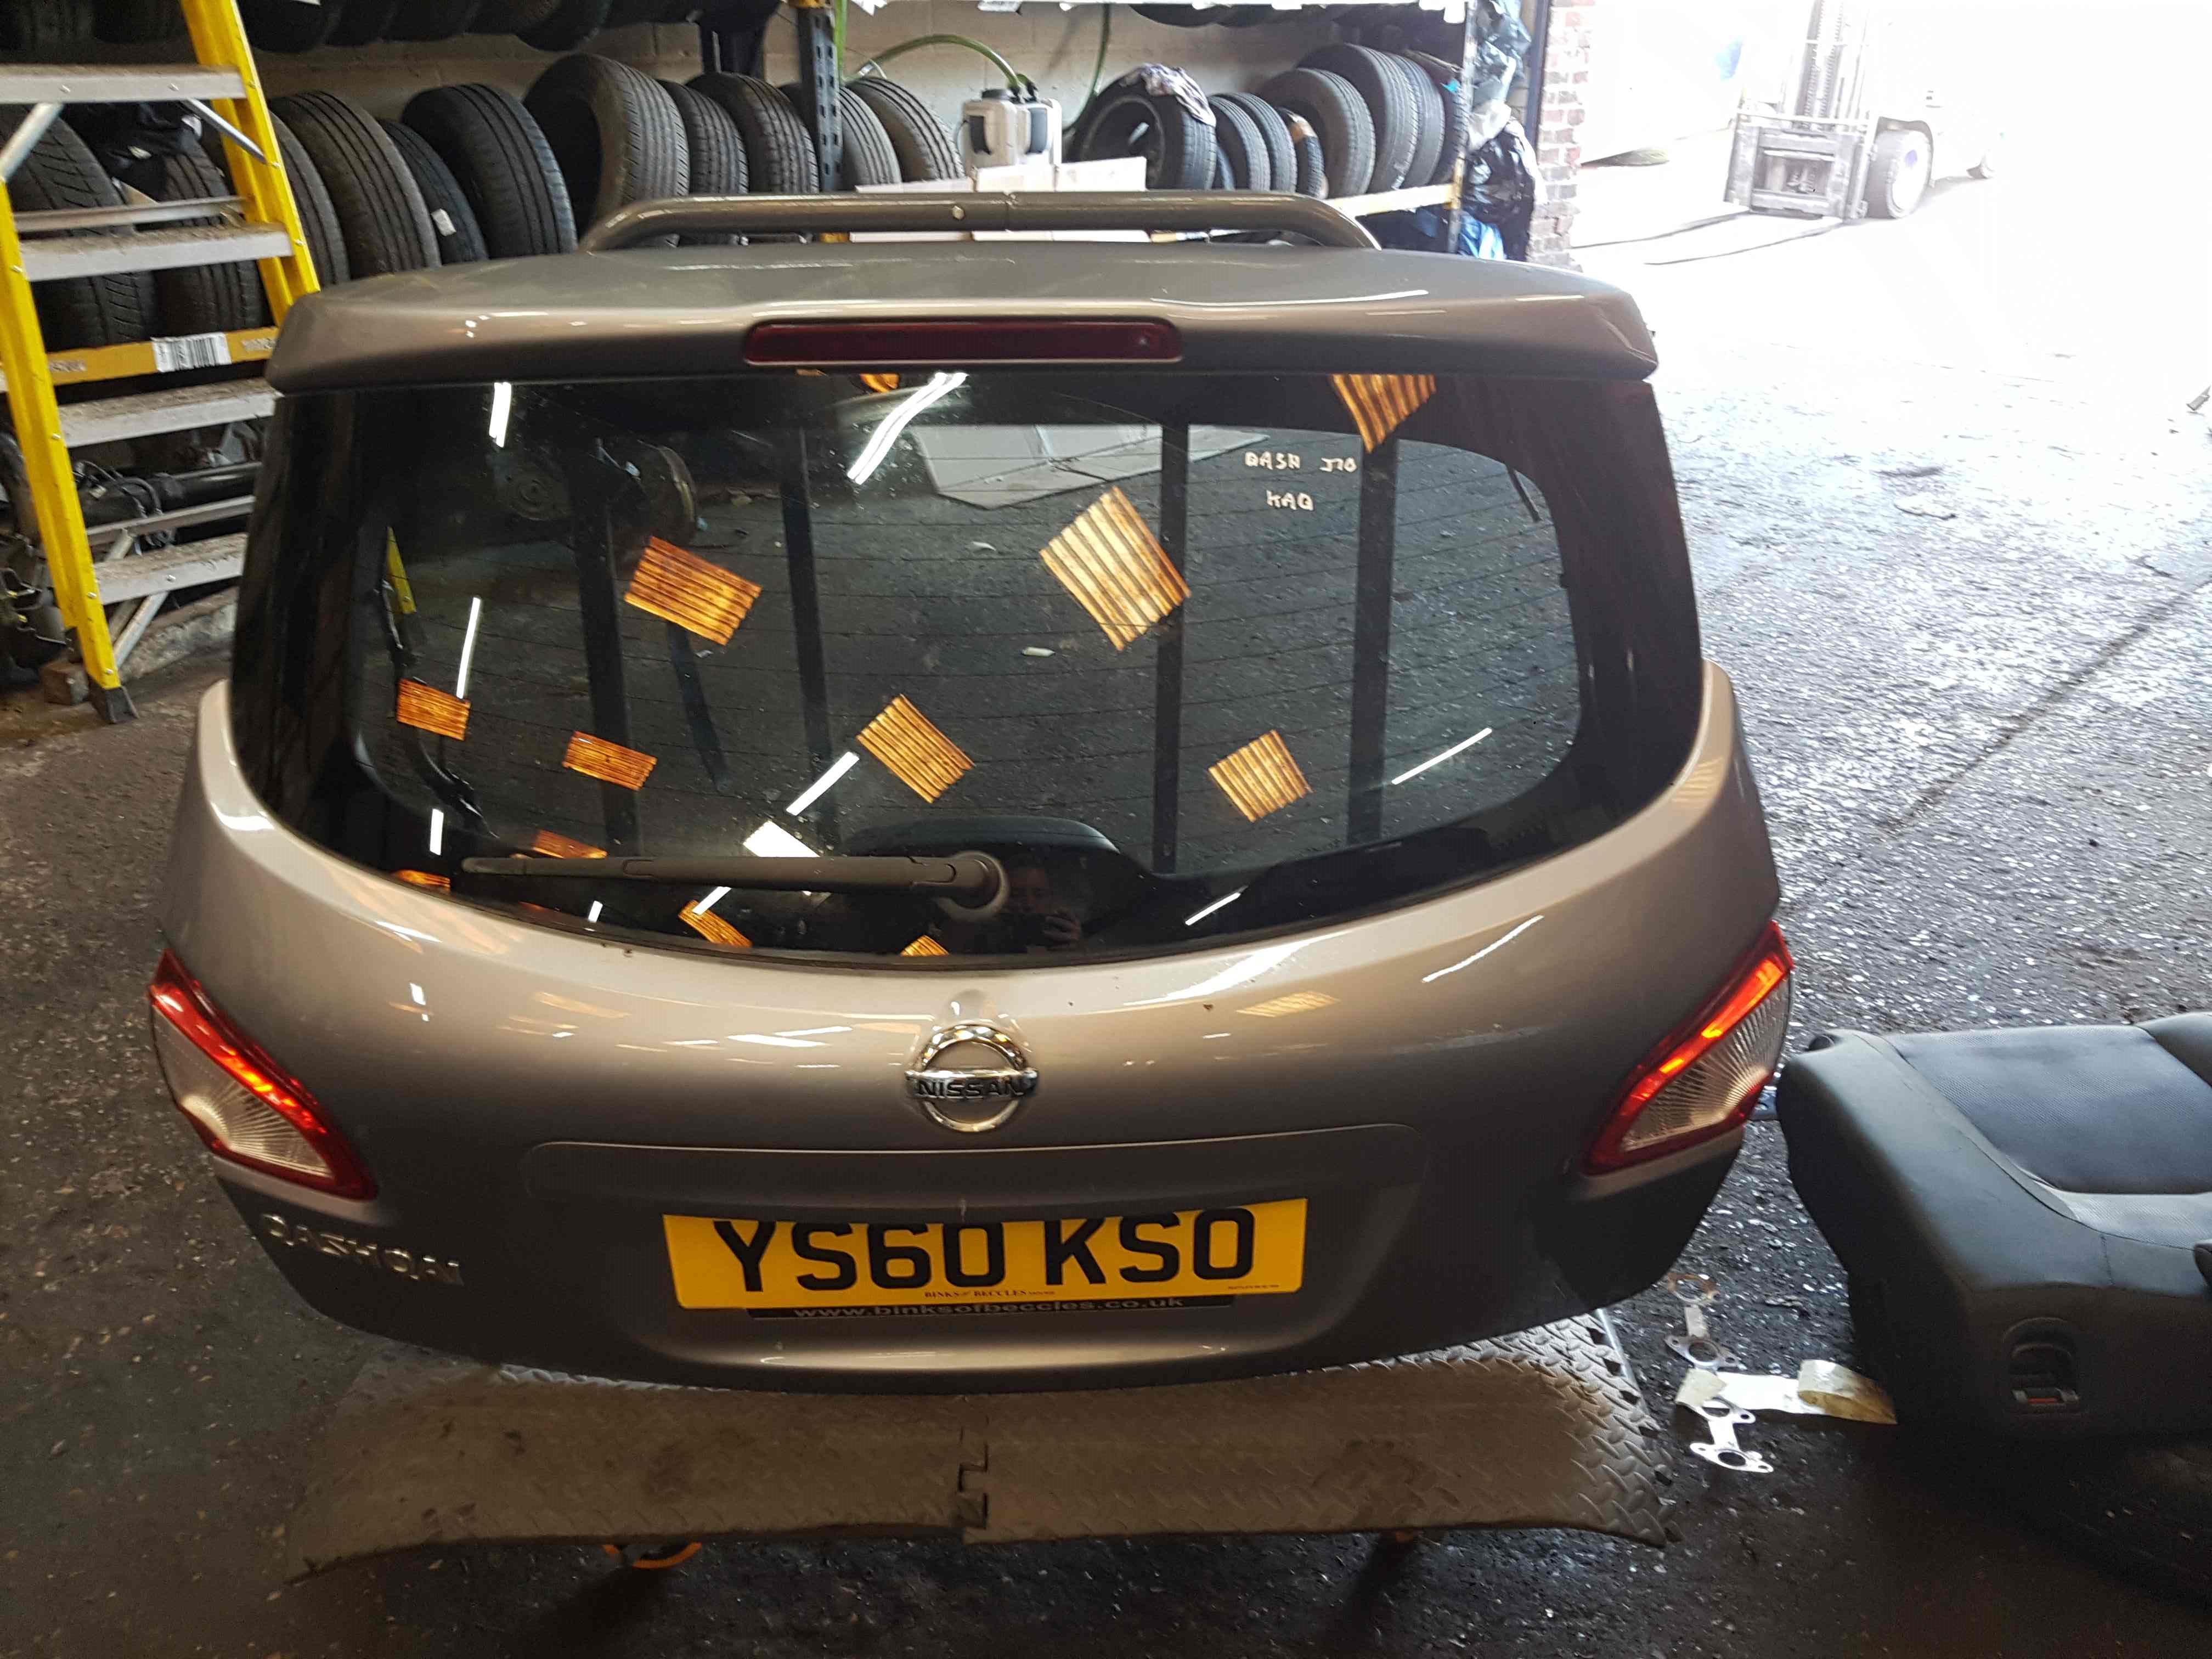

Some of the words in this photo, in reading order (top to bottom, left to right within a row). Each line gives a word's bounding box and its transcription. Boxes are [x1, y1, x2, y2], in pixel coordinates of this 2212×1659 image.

[916, 1079, 1025, 1097] NISSAN
[713, 1220, 1005, 1292] YS60
[1045, 1208, 1254, 1285] KSO
[793, 1297, 1184, 1318] www.binksofbeccles.co.uk
